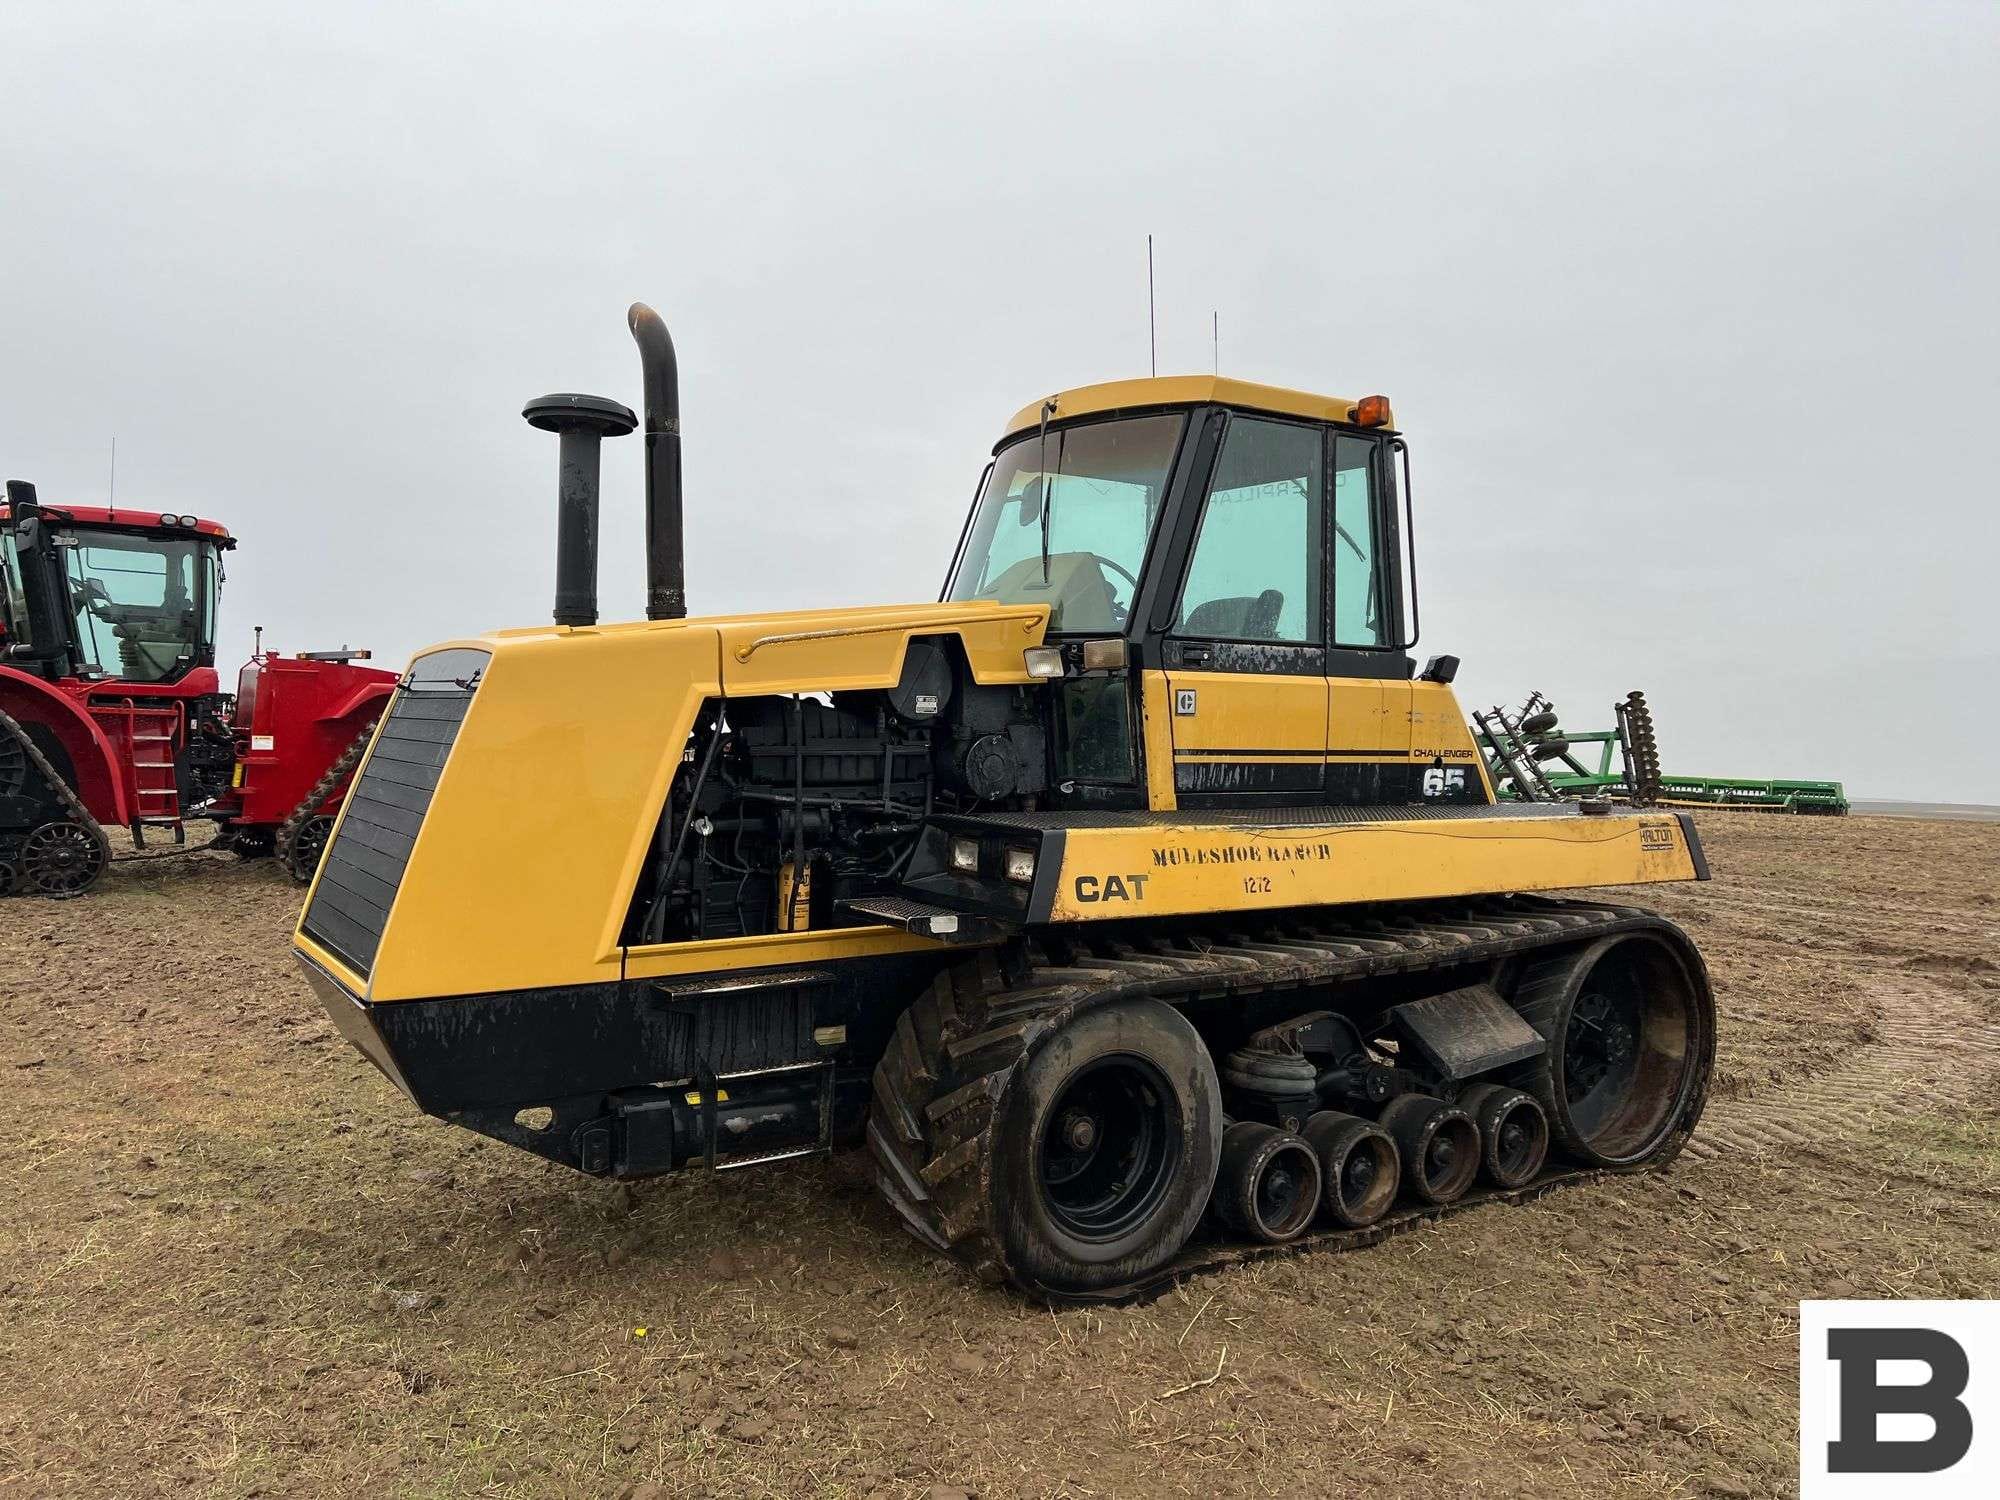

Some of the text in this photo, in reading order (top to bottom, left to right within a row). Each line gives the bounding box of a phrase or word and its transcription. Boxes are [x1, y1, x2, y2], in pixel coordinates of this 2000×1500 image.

[1413, 749, 1473, 758] CHALLENGER
[1423, 768, 1465, 796] 65
[1151, 846, 1262, 867] MULESHOE
[1075, 874, 1149, 903] CAT
[1244, 877, 1272, 893] 1272
